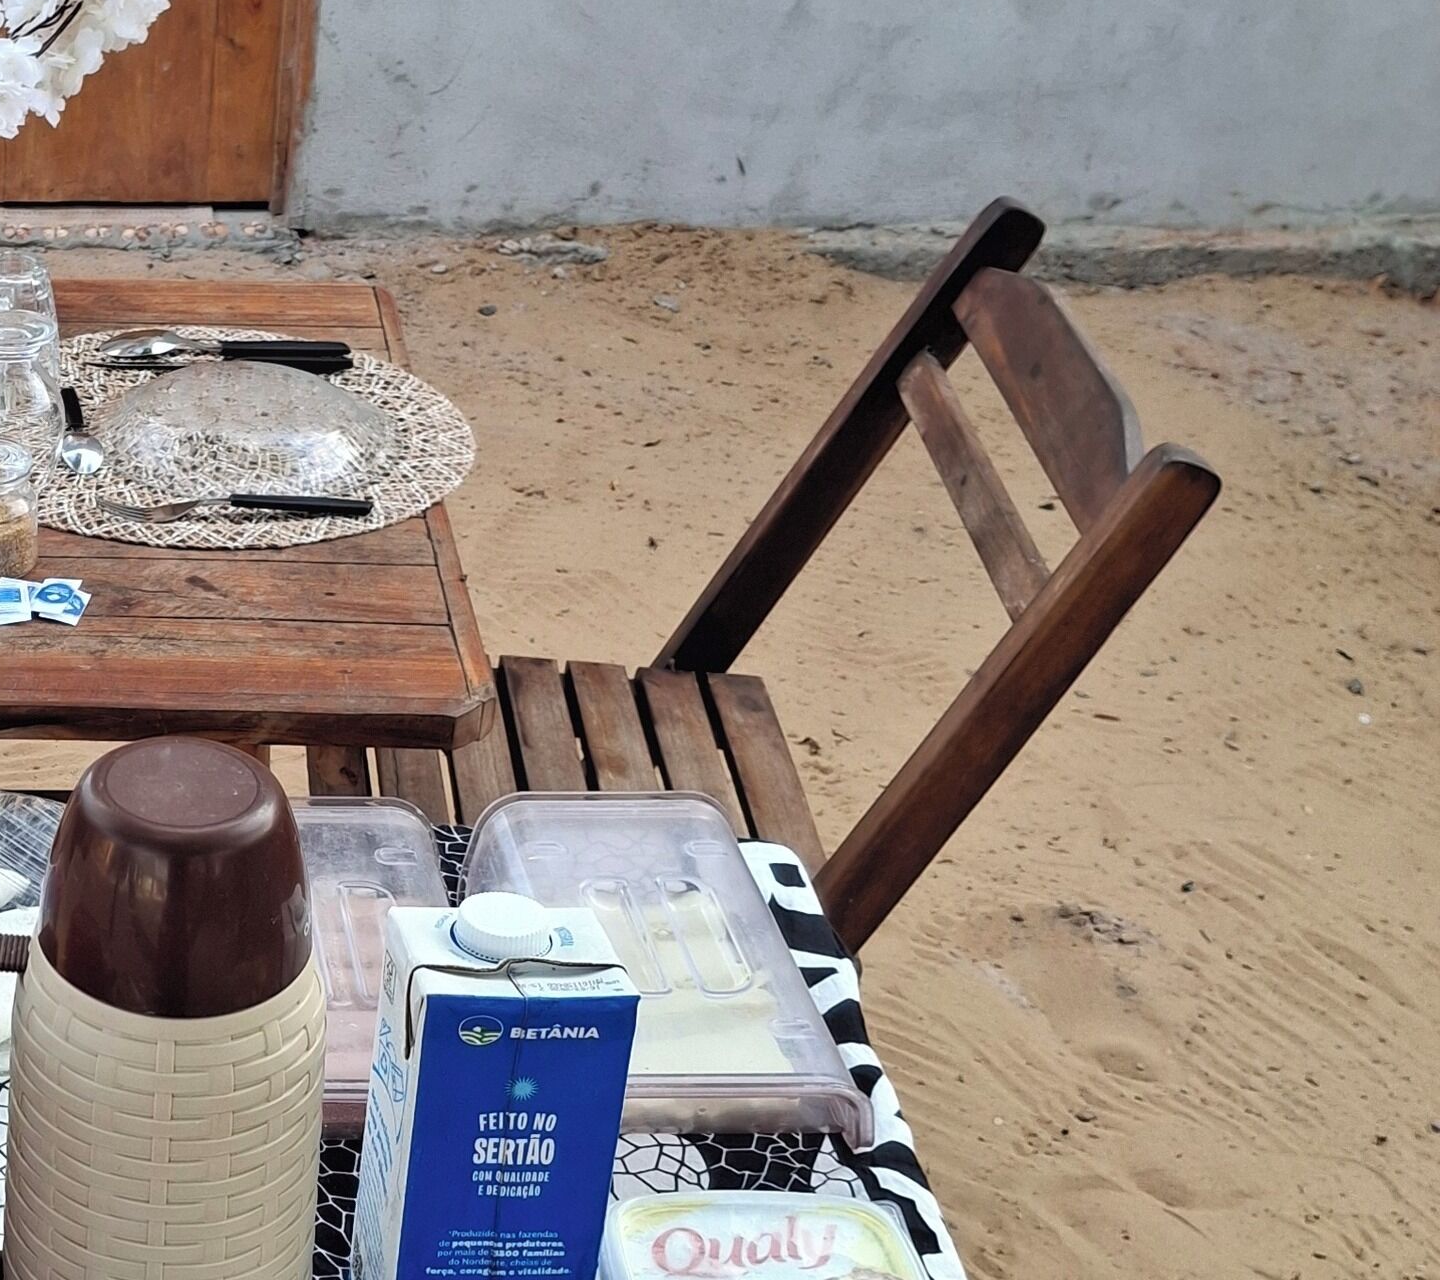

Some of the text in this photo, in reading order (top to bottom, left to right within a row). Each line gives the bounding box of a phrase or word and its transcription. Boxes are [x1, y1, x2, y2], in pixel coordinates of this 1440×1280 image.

[509, 1023, 600, 1039] BETÂNIA
[478, 1111, 558, 1132] FEITO NO
[472, 1133, 556, 1166] SERTÃO
[471, 1170, 551, 1184] COM QUALIDADE
[477, 1183, 542, 1199] E DEDICAÇÃO
[500, 1231, 516, 1239] nas
[518, 1229, 559, 1239] fazendas
[438, 1239, 451, 1248] de
[650, 1215, 838, 1279] Qualy
